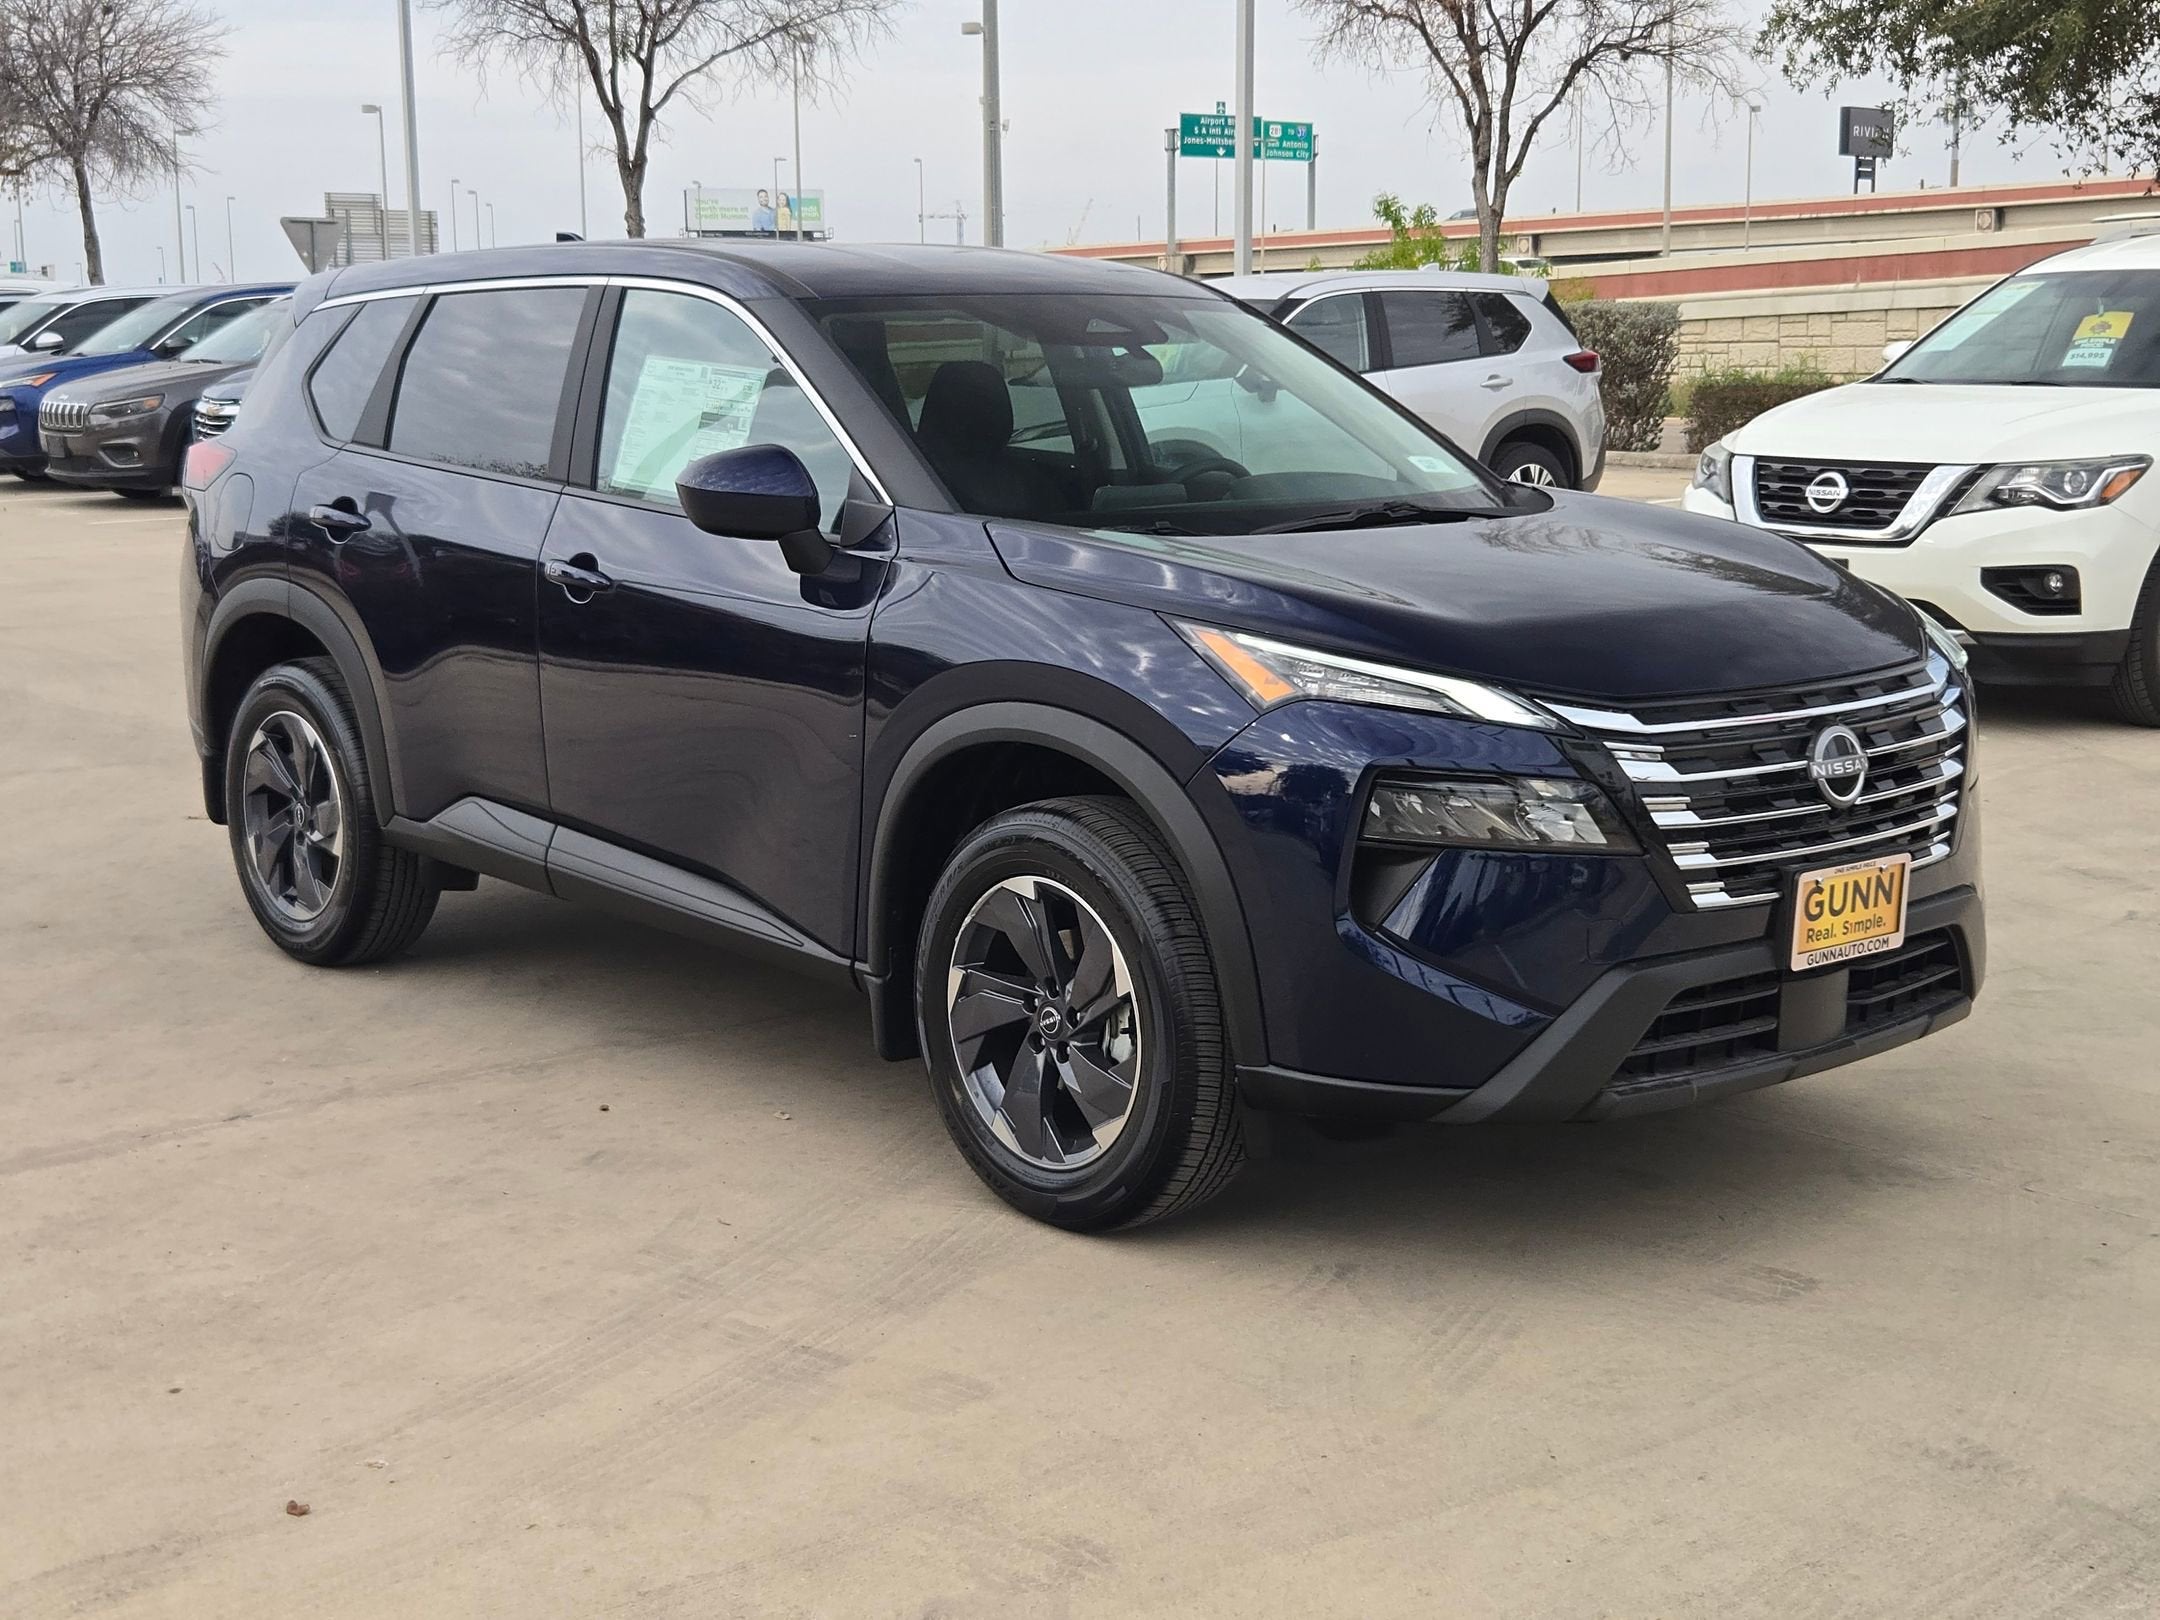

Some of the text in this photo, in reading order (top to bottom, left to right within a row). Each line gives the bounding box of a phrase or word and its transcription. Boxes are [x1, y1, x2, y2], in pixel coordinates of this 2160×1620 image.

[1200, 116, 1225, 126] Airport
[1194, 126, 1199, 135] S
[1202, 127, 1207, 135] A
[1282, 140, 1309, 149] Antonio
[1266, 149, 1310, 160] Johnson City
[1807, 489, 1841, 497] NISSAN
[1812, 757, 1868, 777] NISSAN
[1804, 872, 1895, 922] GUNN
[1806, 923, 1837, 943] Real.
[1807, 936, 1890, 966] GUNNAUTO.COM
